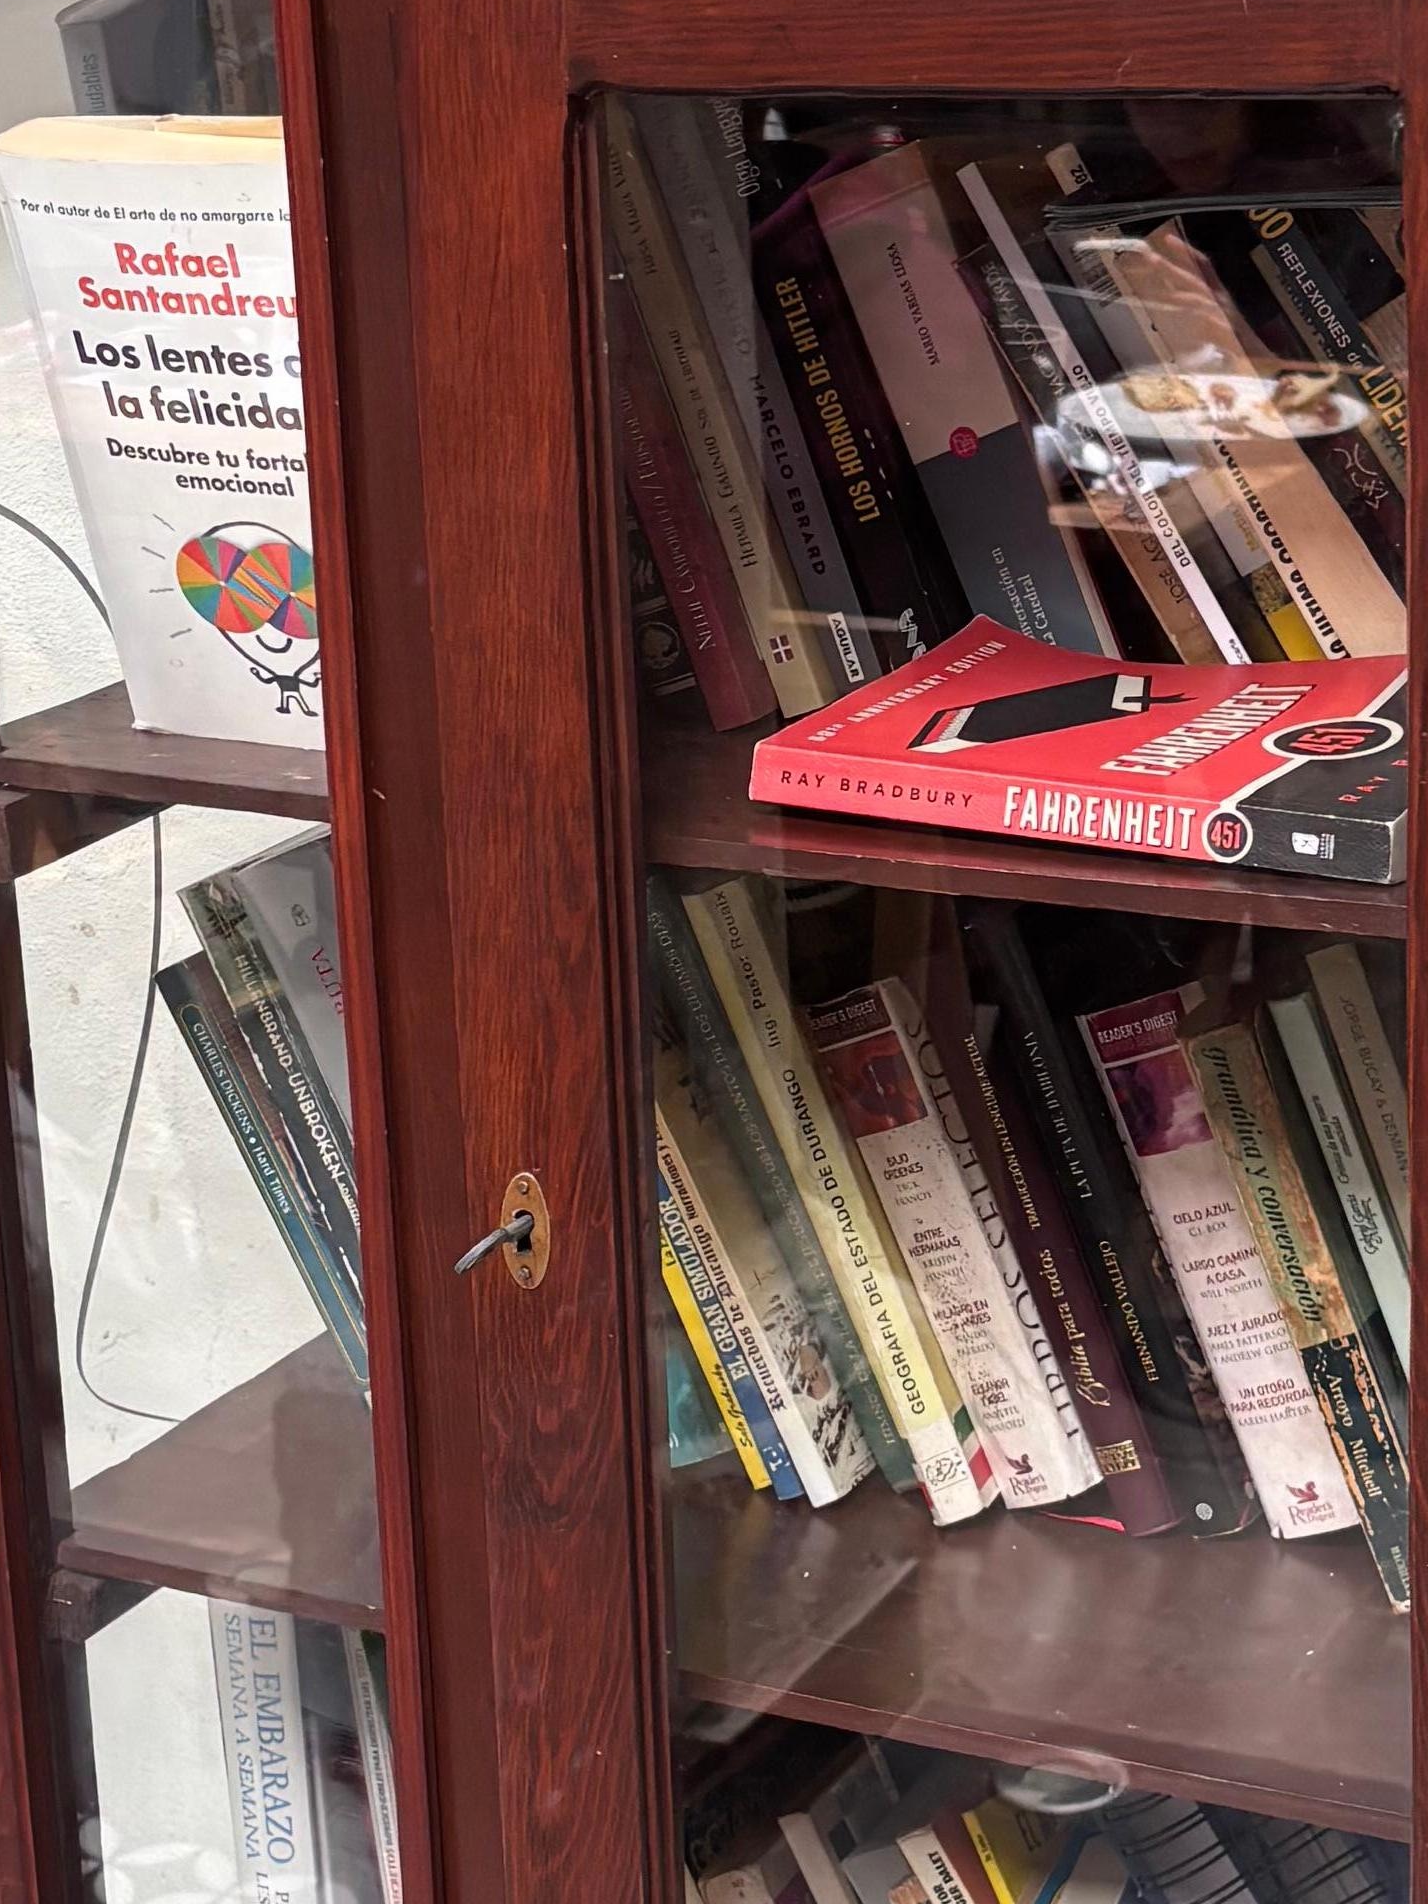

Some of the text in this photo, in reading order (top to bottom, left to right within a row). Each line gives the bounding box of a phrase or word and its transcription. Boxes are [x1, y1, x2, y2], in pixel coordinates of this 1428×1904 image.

[726, 155, 765, 199] Olga
[20, 197, 274, 225] Por el autor de El arte de no amargarse
[114, 241, 241, 278] Rafael
[78, 276, 297, 318] Santandreu
[884, 240, 940, 366] MARIO VARGAS LLOSA
[1271, 240, 1358, 351] REFLEXIONES
[72, 329, 273, 377] Los lentes
[101, 380, 303, 430] la felicida
[773, 274, 881, 523] LOS HORNOS DE HITLER
[105, 437, 240, 468] Descubre tu
[1093, 404, 1130, 460] TIEMPO
[175, 473, 295, 497] emocional
[745, 373, 829, 577] MARCELO EBRARD
[1123, 458, 1147, 490] DEL
[1140, 488, 1175, 539] COLOR
[990, 545, 1005, 564] en
[1167, 537, 1192, 569] DEL
[1015, 572, 1049, 632] Catedral
[827, 616, 863, 679] AGUILAR
[847, 640, 1008, 724] ANNIVERSARY EDITION
[1101, 682, 1319, 777] FAHRENHEIT
[1290, 723, 1376, 756] 451
[779, 768, 974, 808] RAY BRADBURY
[1002, 784, 1198, 851] FAHRENHEIT
[1209, 819, 1242, 849] 451
[756, 1013, 784, 1049] Ing.
[188, 1020, 295, 1216] CHARLES DICKENS Hard Times
[282, 1070, 349, 1181] UNBROKEN
[1356, 1044, 1412, 1172] BUCAY DEMIAN
[1002, 1153, 1042, 1231] TRADUCCIÓN
[1074, 1176, 1094, 1200] LA
[1173, 1202, 1237, 1224] CIELO AZUL
[769, 1065, 927, 1418] GEOGRAFIA DEL ESTADO DE DURANGO
[1243, 1159, 1331, 1327] y conversación
[656, 1191, 750, 1381] EL GRAN SIMULADOR
[659, 1149, 787, 1415] Recuerdos Durango Narraciones
[1215, 1267, 1247, 1283] CASA
[1031, 1247, 1115, 1416] Biblia para todos
[1097, 1238, 1161, 1384] FERNANDO VALLEJO
[1324, 1371, 1383, 1499] Arroyo Mitchell
[220, 1610, 265, 1860] SEMANA A SEMANA
[247, 1614, 297, 1866] EL EMBARAZO
